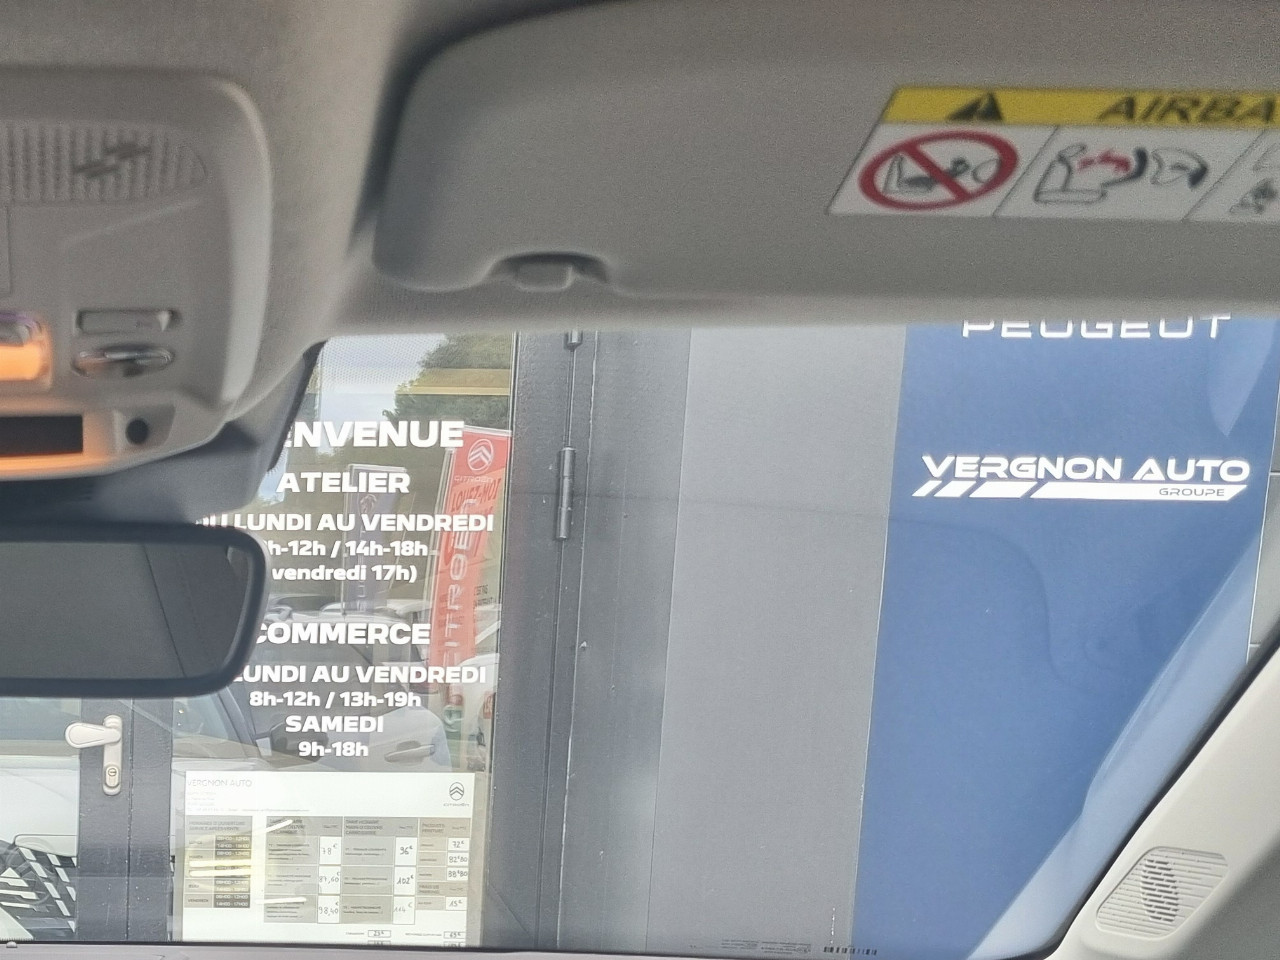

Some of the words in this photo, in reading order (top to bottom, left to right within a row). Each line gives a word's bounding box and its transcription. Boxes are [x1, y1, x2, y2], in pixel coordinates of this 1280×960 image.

[922, 454, 1122, 480] VERGNON
[1132, 458, 1250, 482] AUTO
[276, 472, 410, 493] ATELIER
[1158, 487, 1225, 497] GROUPE
[234, 513, 311, 531] LUNDI
[317, 513, 355, 531] AU
[361, 513, 494, 532] VENDREDI
[263, 540, 326, 556] h-12h
[345, 540, 428, 556] 14h-18h
[272, 564, 366, 580] vendredi
[371, 565, 417, 583] 17h)
[311, 665, 350, 683] AU
[355, 665, 486, 684] VENDREDI
[249, 690, 321, 706] 8h-12h
[340, 691, 421, 707] 13h-19h
[285, 715, 384, 733] SAMEDI
[298, 740, 369, 757] 9h-18h
